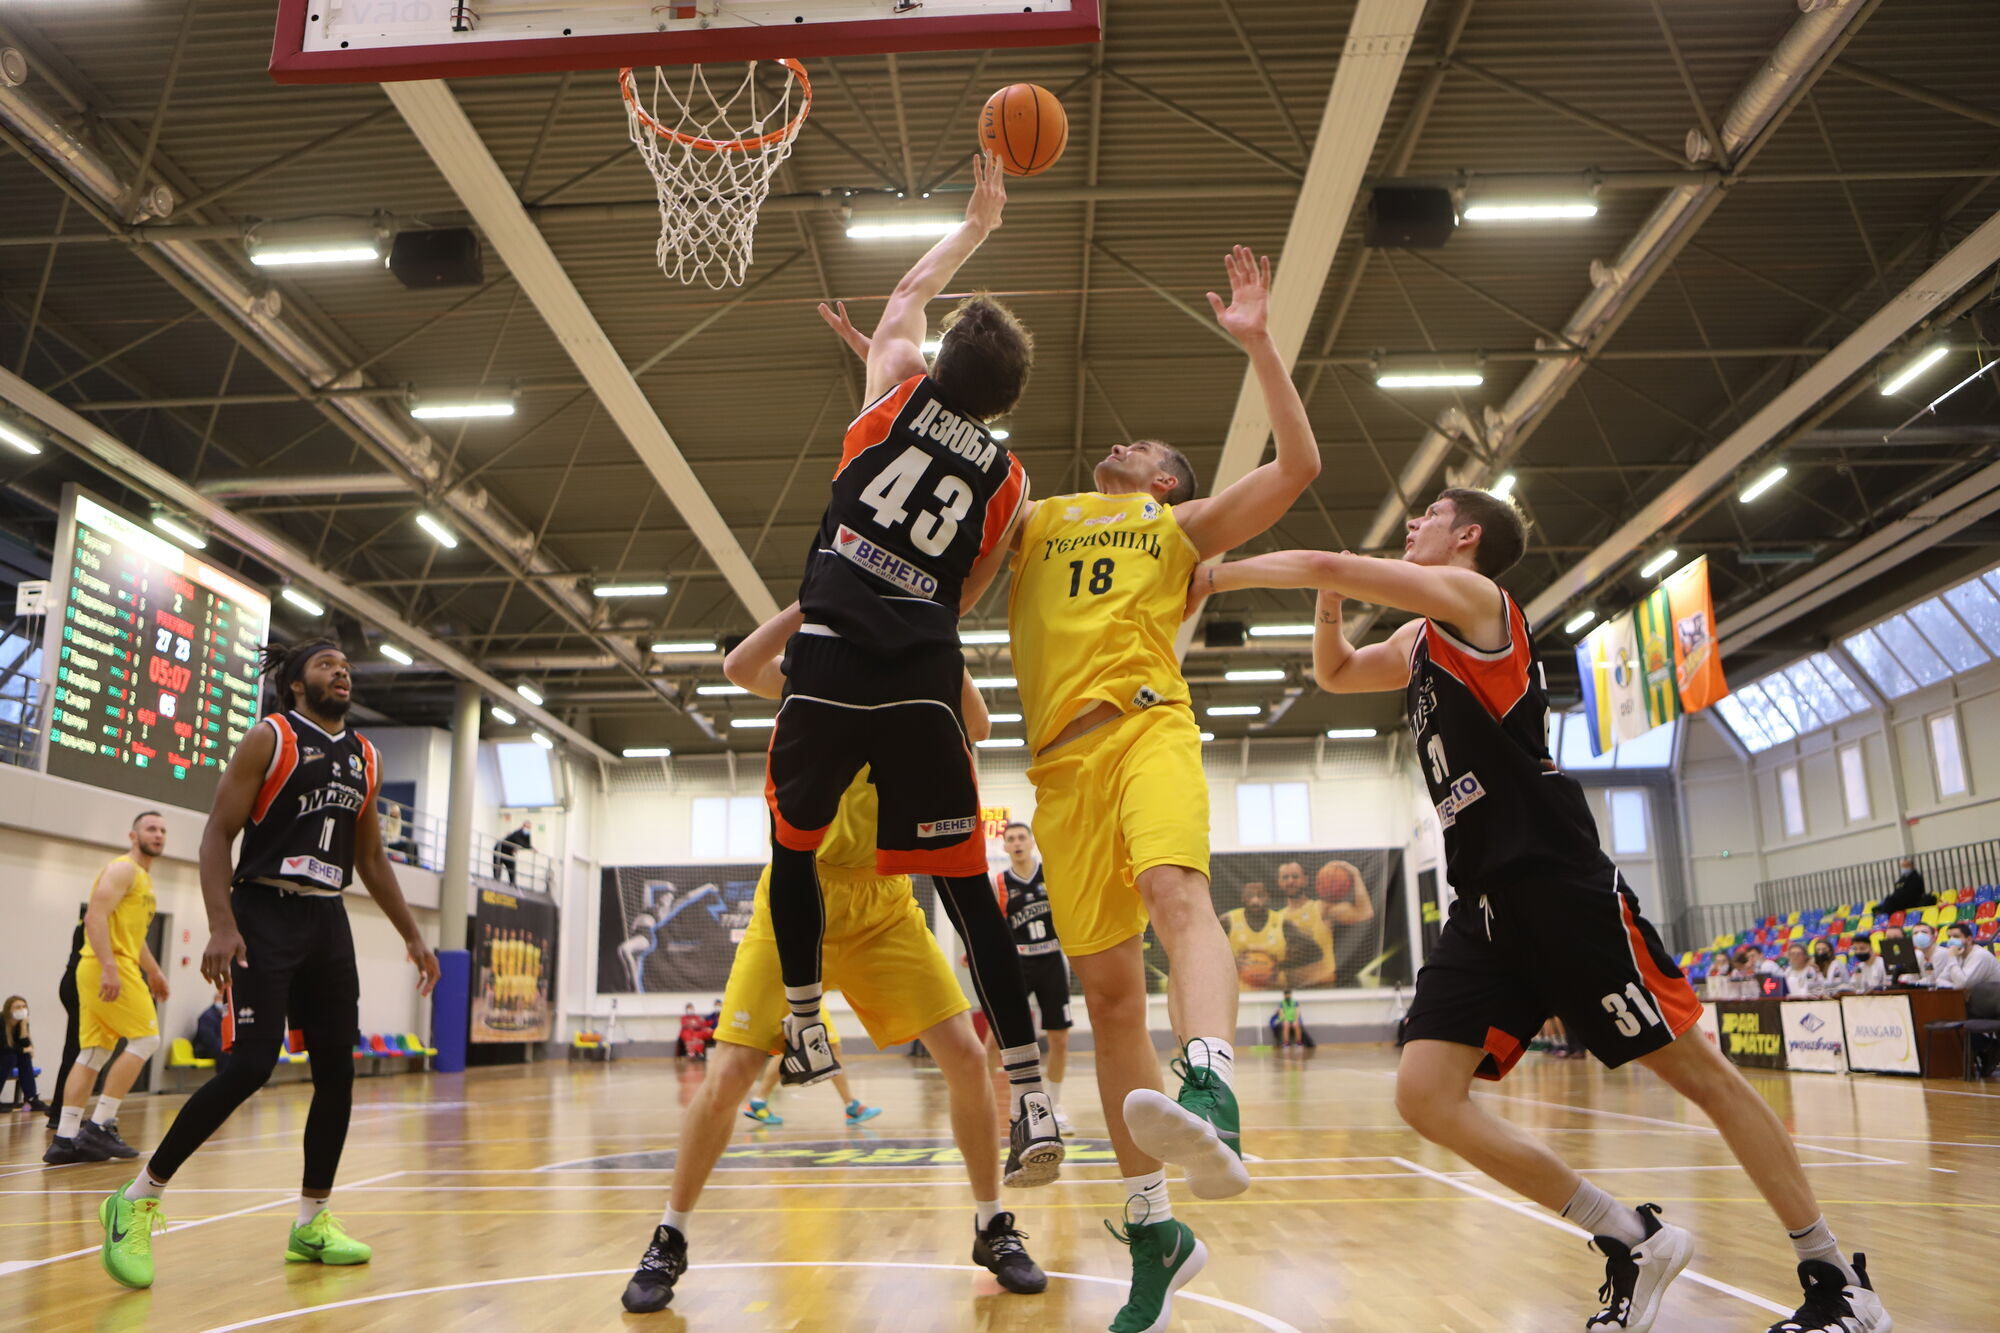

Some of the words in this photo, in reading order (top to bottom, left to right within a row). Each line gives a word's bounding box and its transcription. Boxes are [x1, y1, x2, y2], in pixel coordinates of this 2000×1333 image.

[908, 398, 998, 474] ДЗЮБА
[859, 445, 974, 557] 43
[855, 540, 936, 594] ВЕНЕТО
[1069, 557, 1116, 598] 18
[173, 593, 183, 614] 2
[155, 627, 173, 653] 27
[149, 653, 192, 694] 05:07
[1427, 733, 1450, 785] 31
[1028, 920, 1047, 940] 16
[1601, 981, 1661, 1037] 31
[1721, 1013, 1760, 1034] PARI
[1730, 1033, 1781, 1055] MATCH
[1028, 1101, 1040, 1127] adidas
